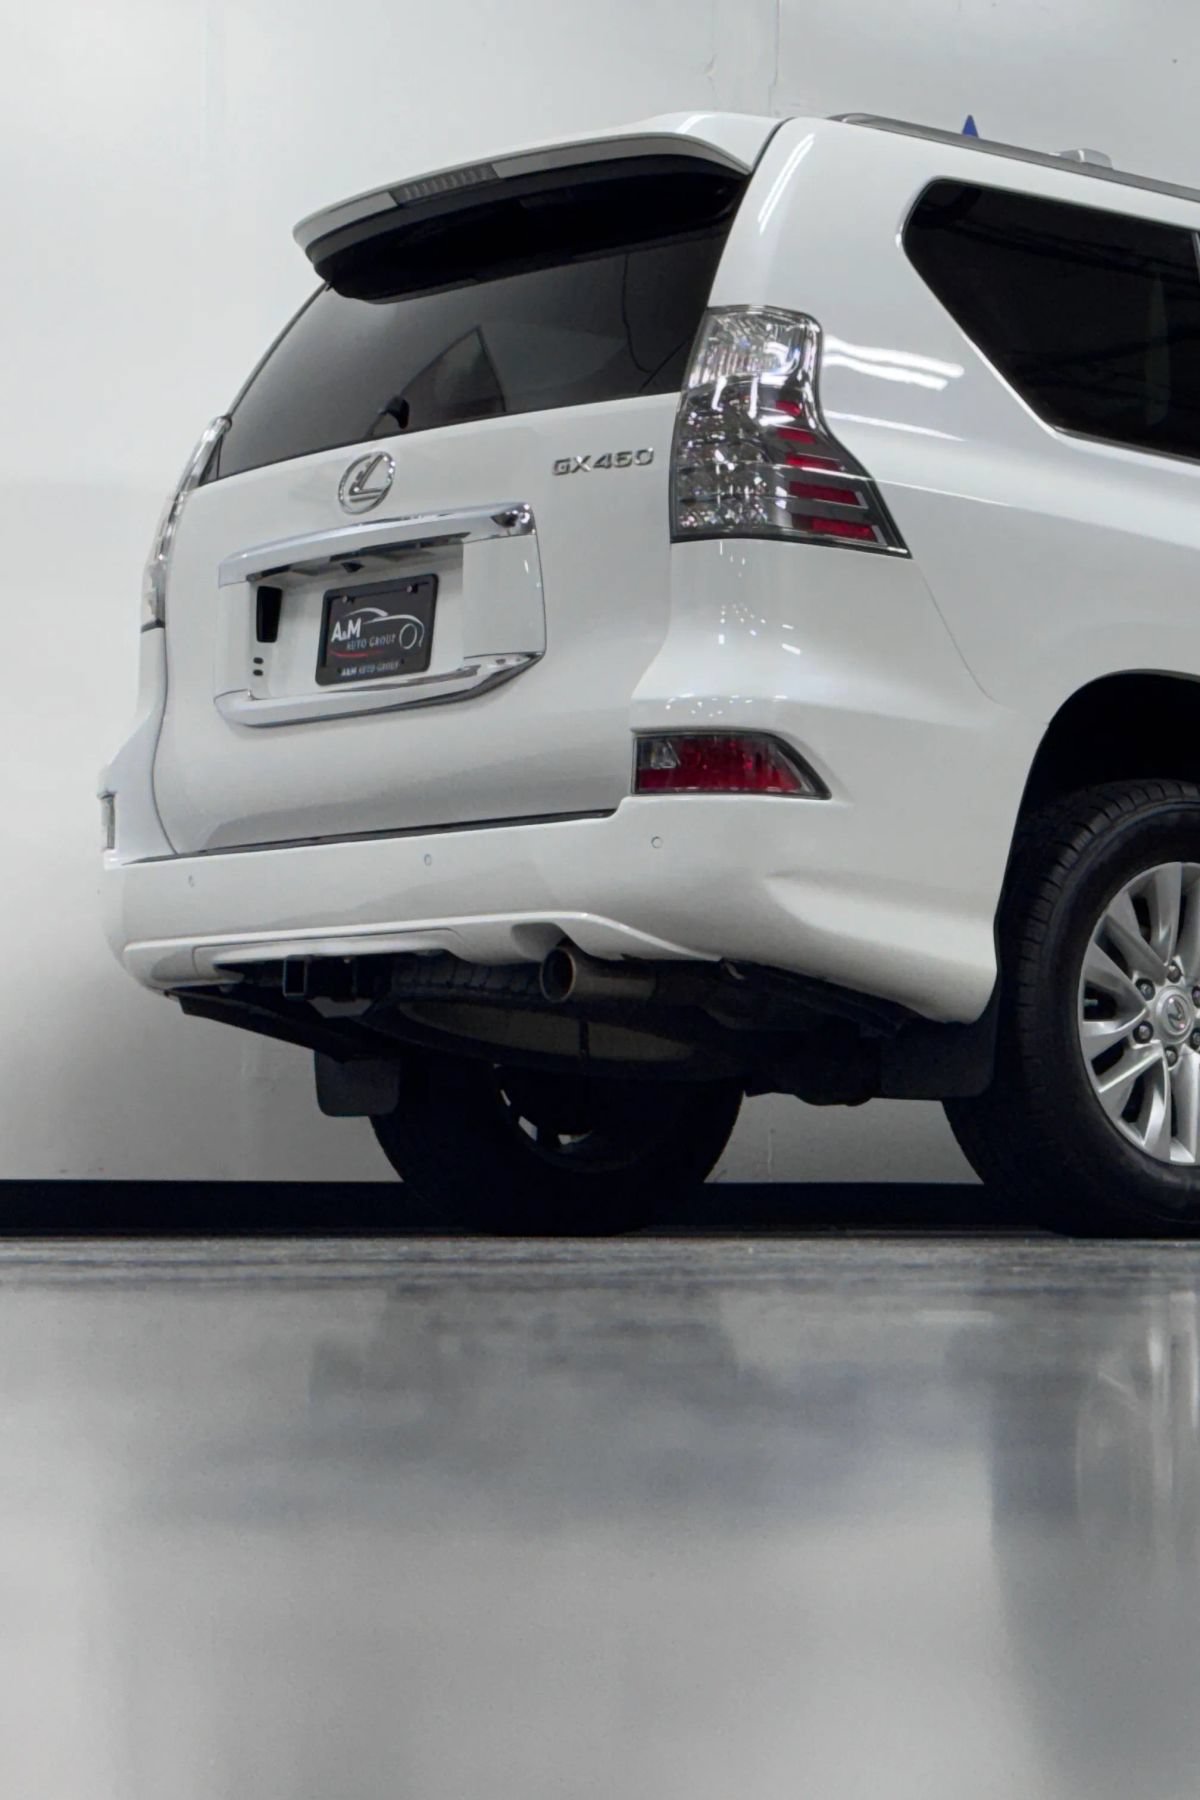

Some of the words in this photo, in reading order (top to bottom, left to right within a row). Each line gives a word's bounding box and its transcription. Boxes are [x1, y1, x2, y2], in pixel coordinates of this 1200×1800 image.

[553, 447, 654, 476] GX460
[331, 617, 362, 643] A&M
[346, 639, 368, 651] AUTO
[369, 633, 396, 648] GROUP
